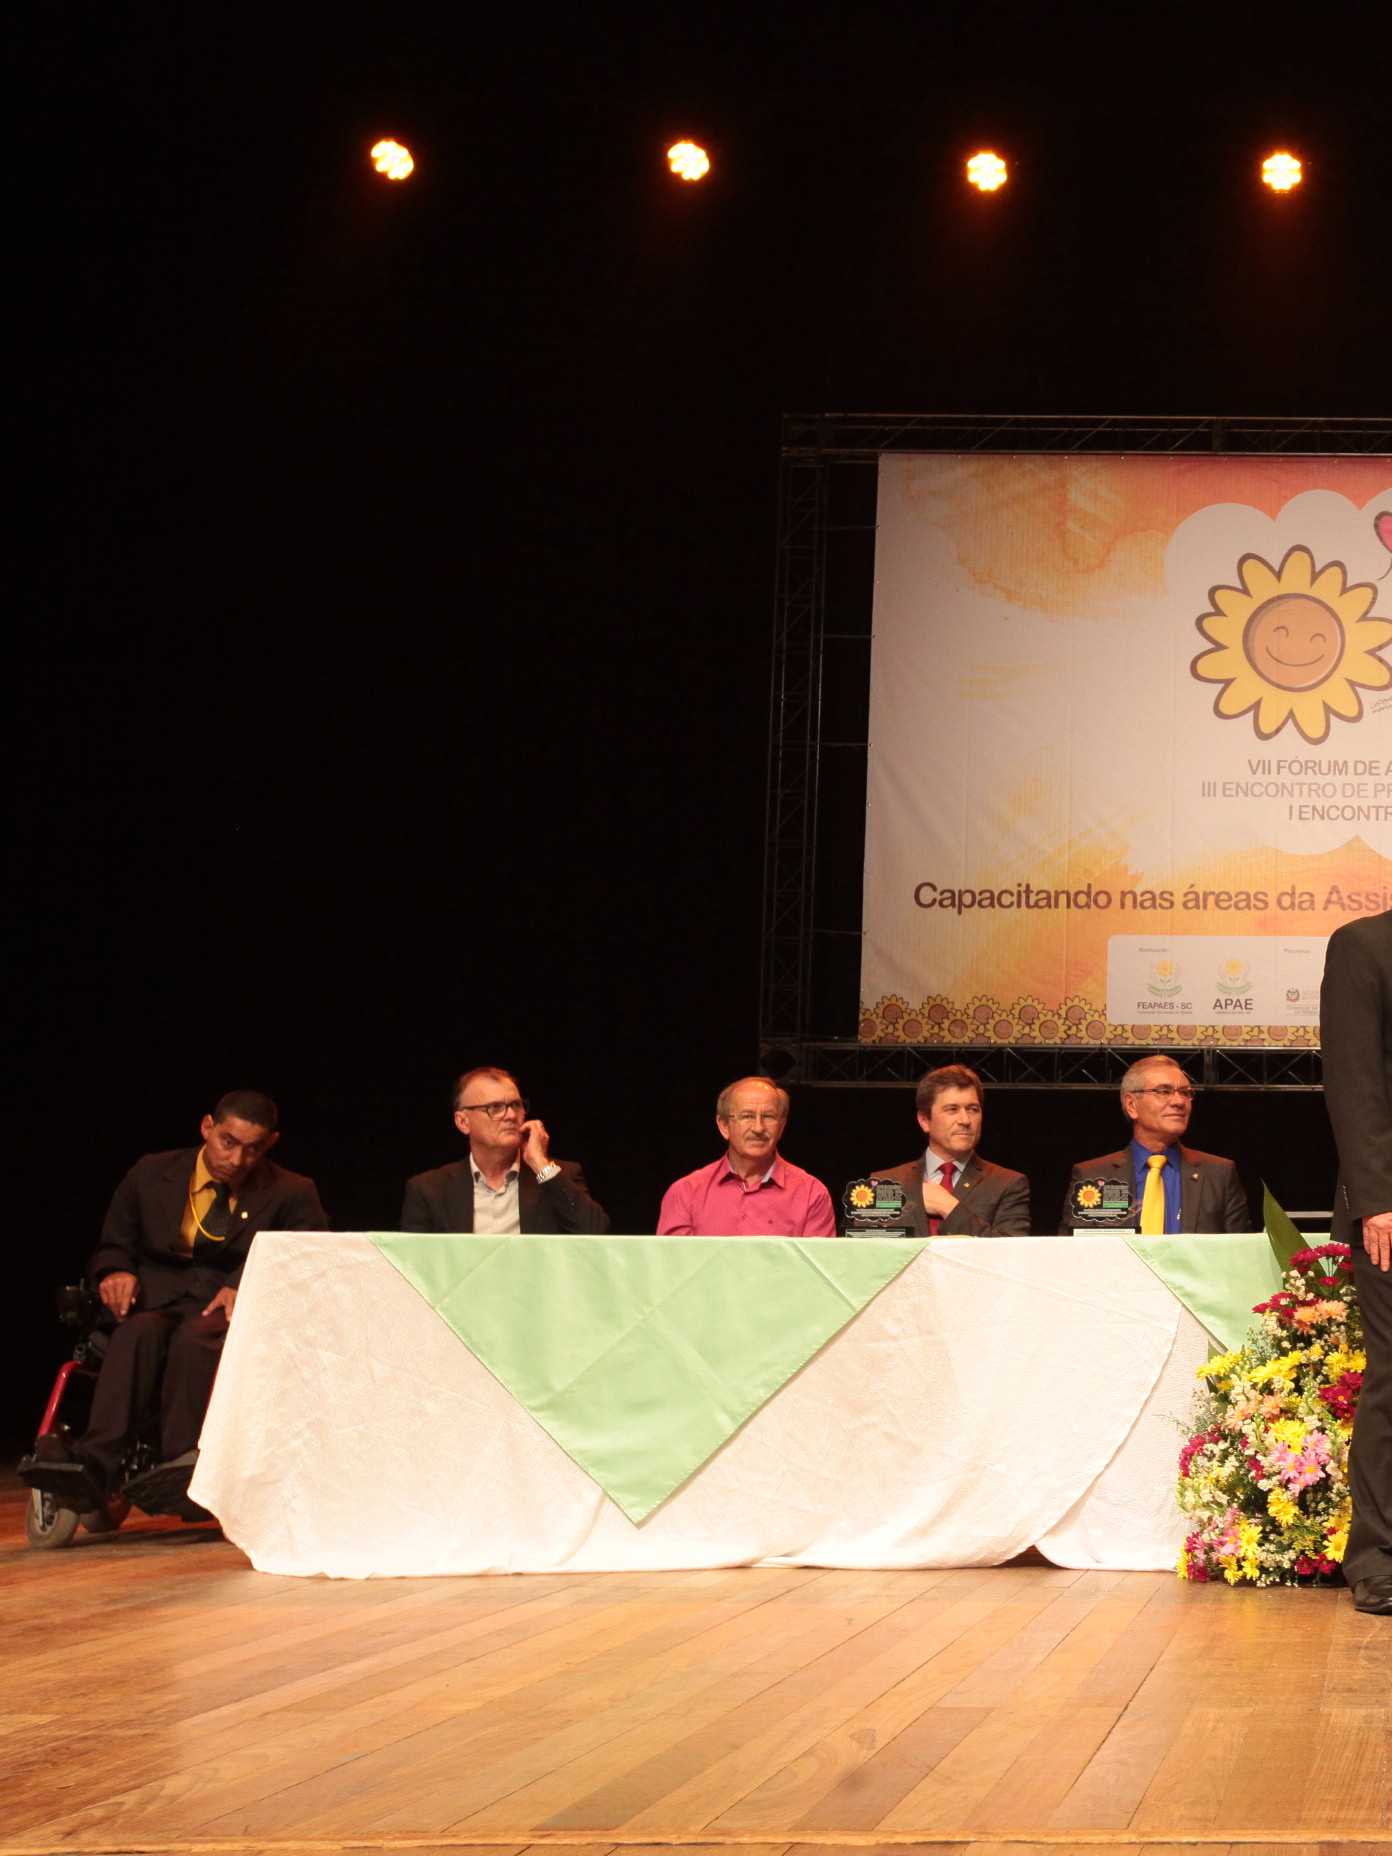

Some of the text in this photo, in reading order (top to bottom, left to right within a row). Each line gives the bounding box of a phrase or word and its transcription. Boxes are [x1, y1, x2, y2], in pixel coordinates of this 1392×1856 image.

[1247, 759, 1272, 775] VII
[1276, 756, 1349, 776] FÓRUM
[1353, 760, 1381, 776] DE
[1201, 781, 1217, 798] III
[1222, 781, 1337, 798] ENCONTRO
[1341, 783, 1369, 798] DE
[1288, 804, 1293, 821] I
[913, 881, 1113, 916] Capacitando
[1119, 889, 1175, 911] nas
[1182, 883, 1269, 912] áreas
[1276, 884, 1316, 912] da
[1137, 1001, 1175, 1010] FEAPAES
[1180, 1002, 1193, 1010] SC
[1212, 998, 1254, 1011] APAE
